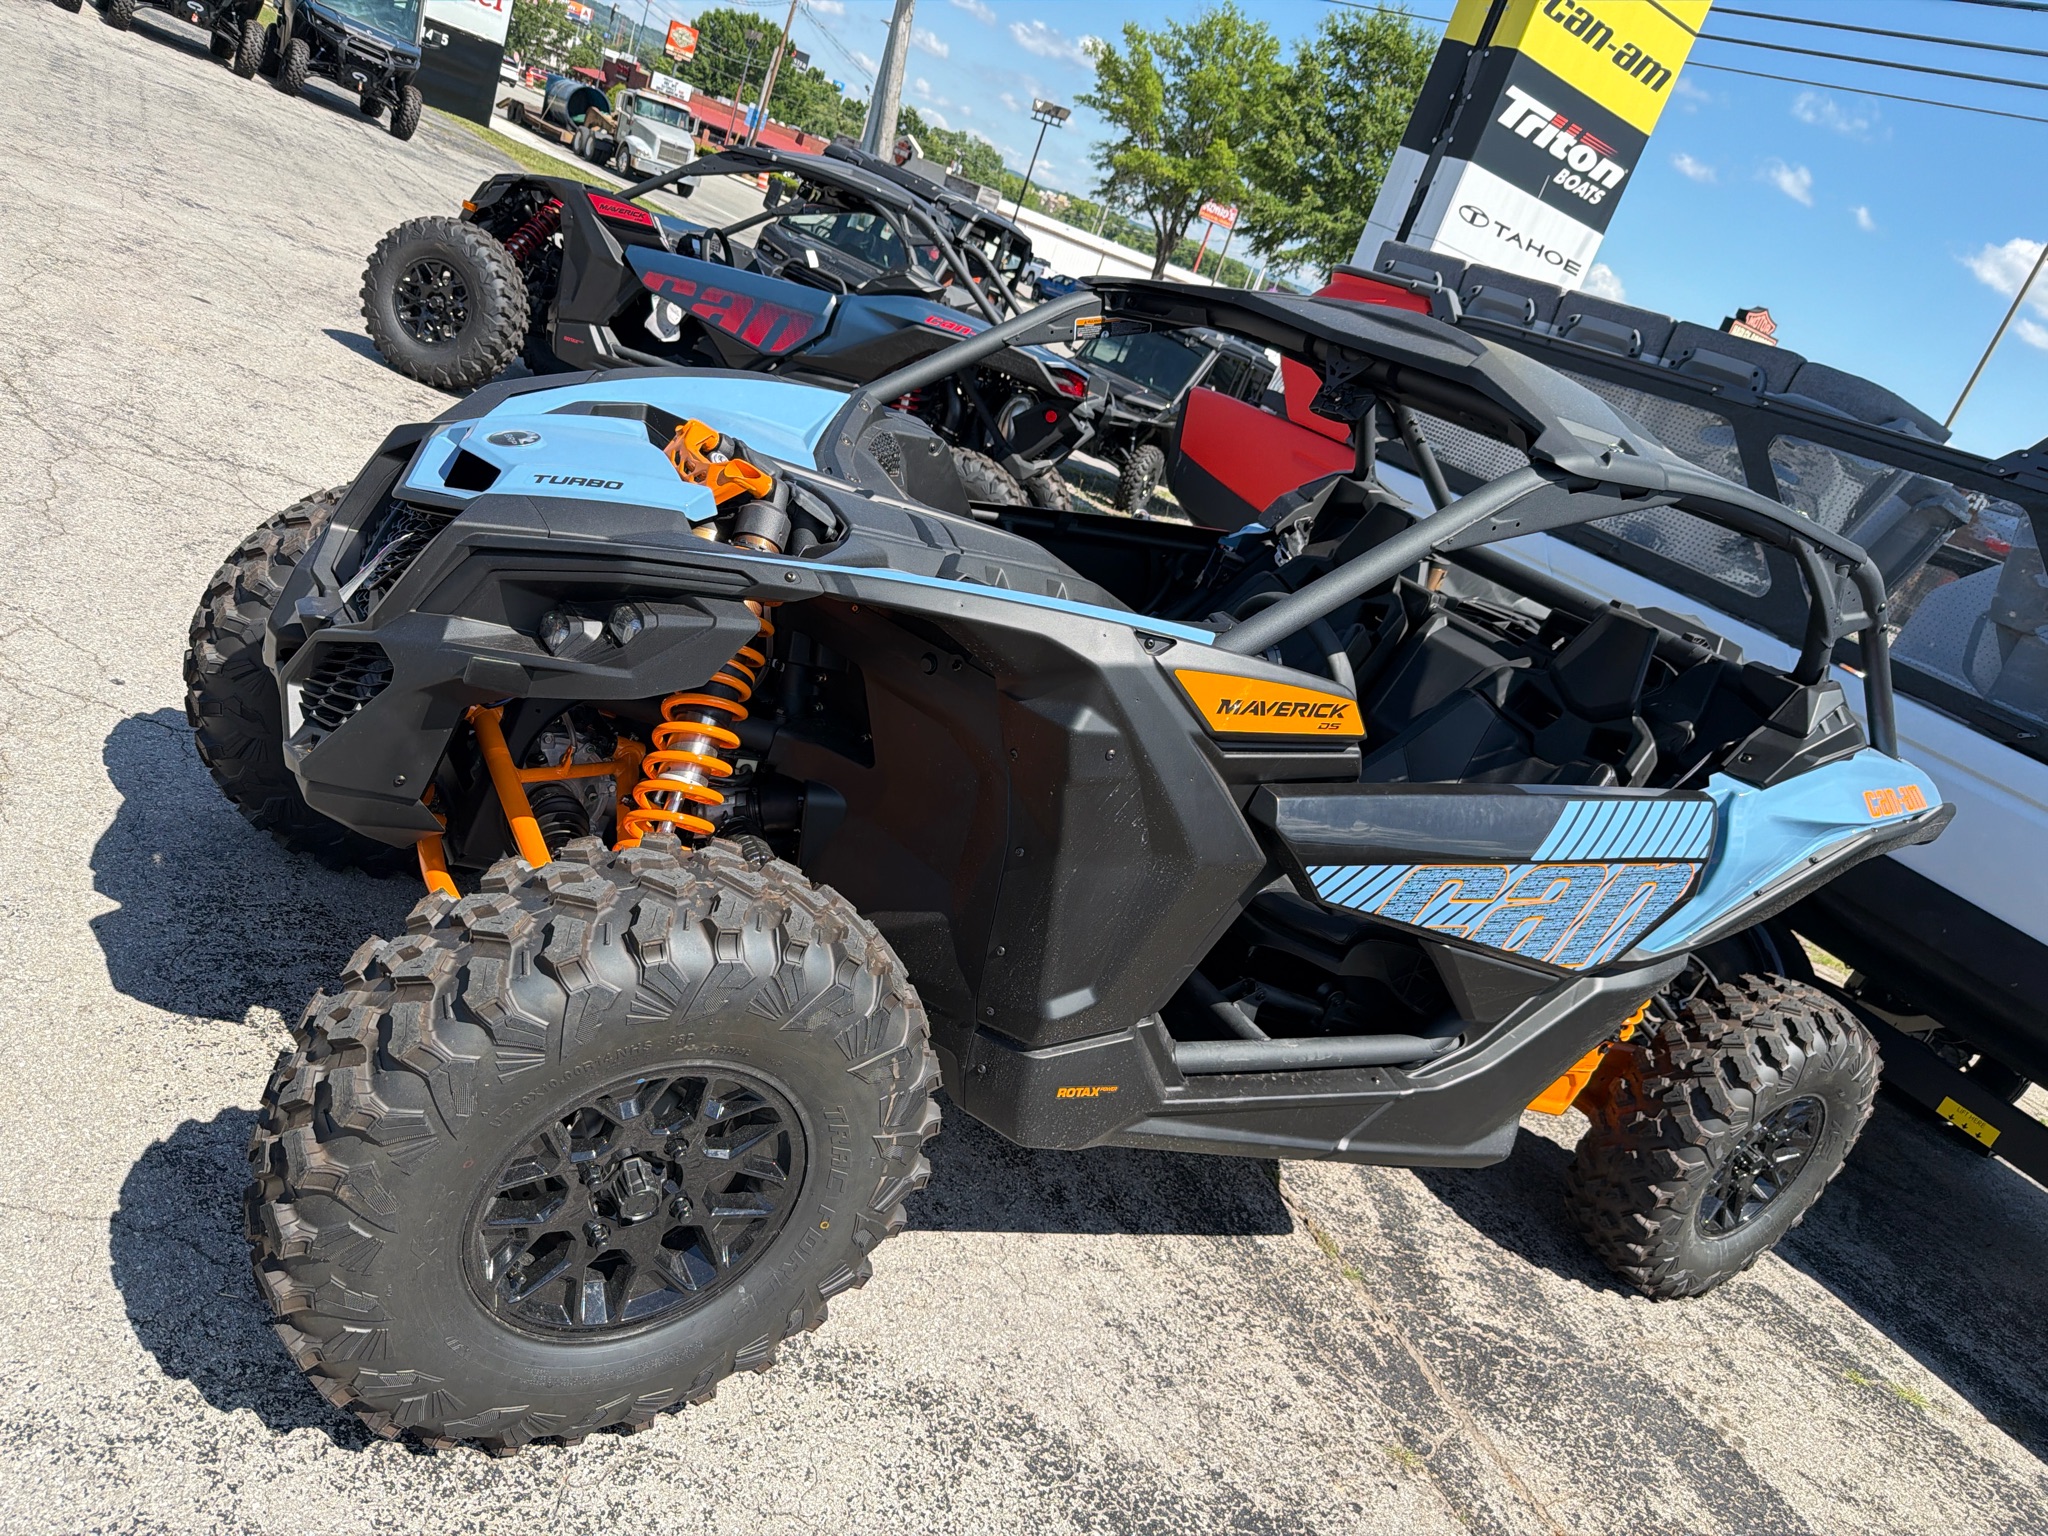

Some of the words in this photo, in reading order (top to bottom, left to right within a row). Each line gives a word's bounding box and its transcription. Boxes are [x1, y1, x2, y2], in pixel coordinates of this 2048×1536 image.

[1543, 0, 1672, 93] can-am
[1497, 85, 1626, 189] Triton
[1553, 168, 1606, 205] BOATS
[599, 203, 645, 219] MAVERICK
[1494, 220, 1582, 277] TAHOE
[534, 475, 624, 490] TURBO
[1216, 698, 1351, 719] MAVERICK
[1317, 722, 1342, 730] DS
[1863, 784, 1928, 818] can-am
[1056, 1086, 1100, 1098] ROTAX
[1956, 1106, 1969, 1117] LIFT
[1969, 1114, 1985, 1128] HERE
[824, 1105, 851, 1194] TRAC
